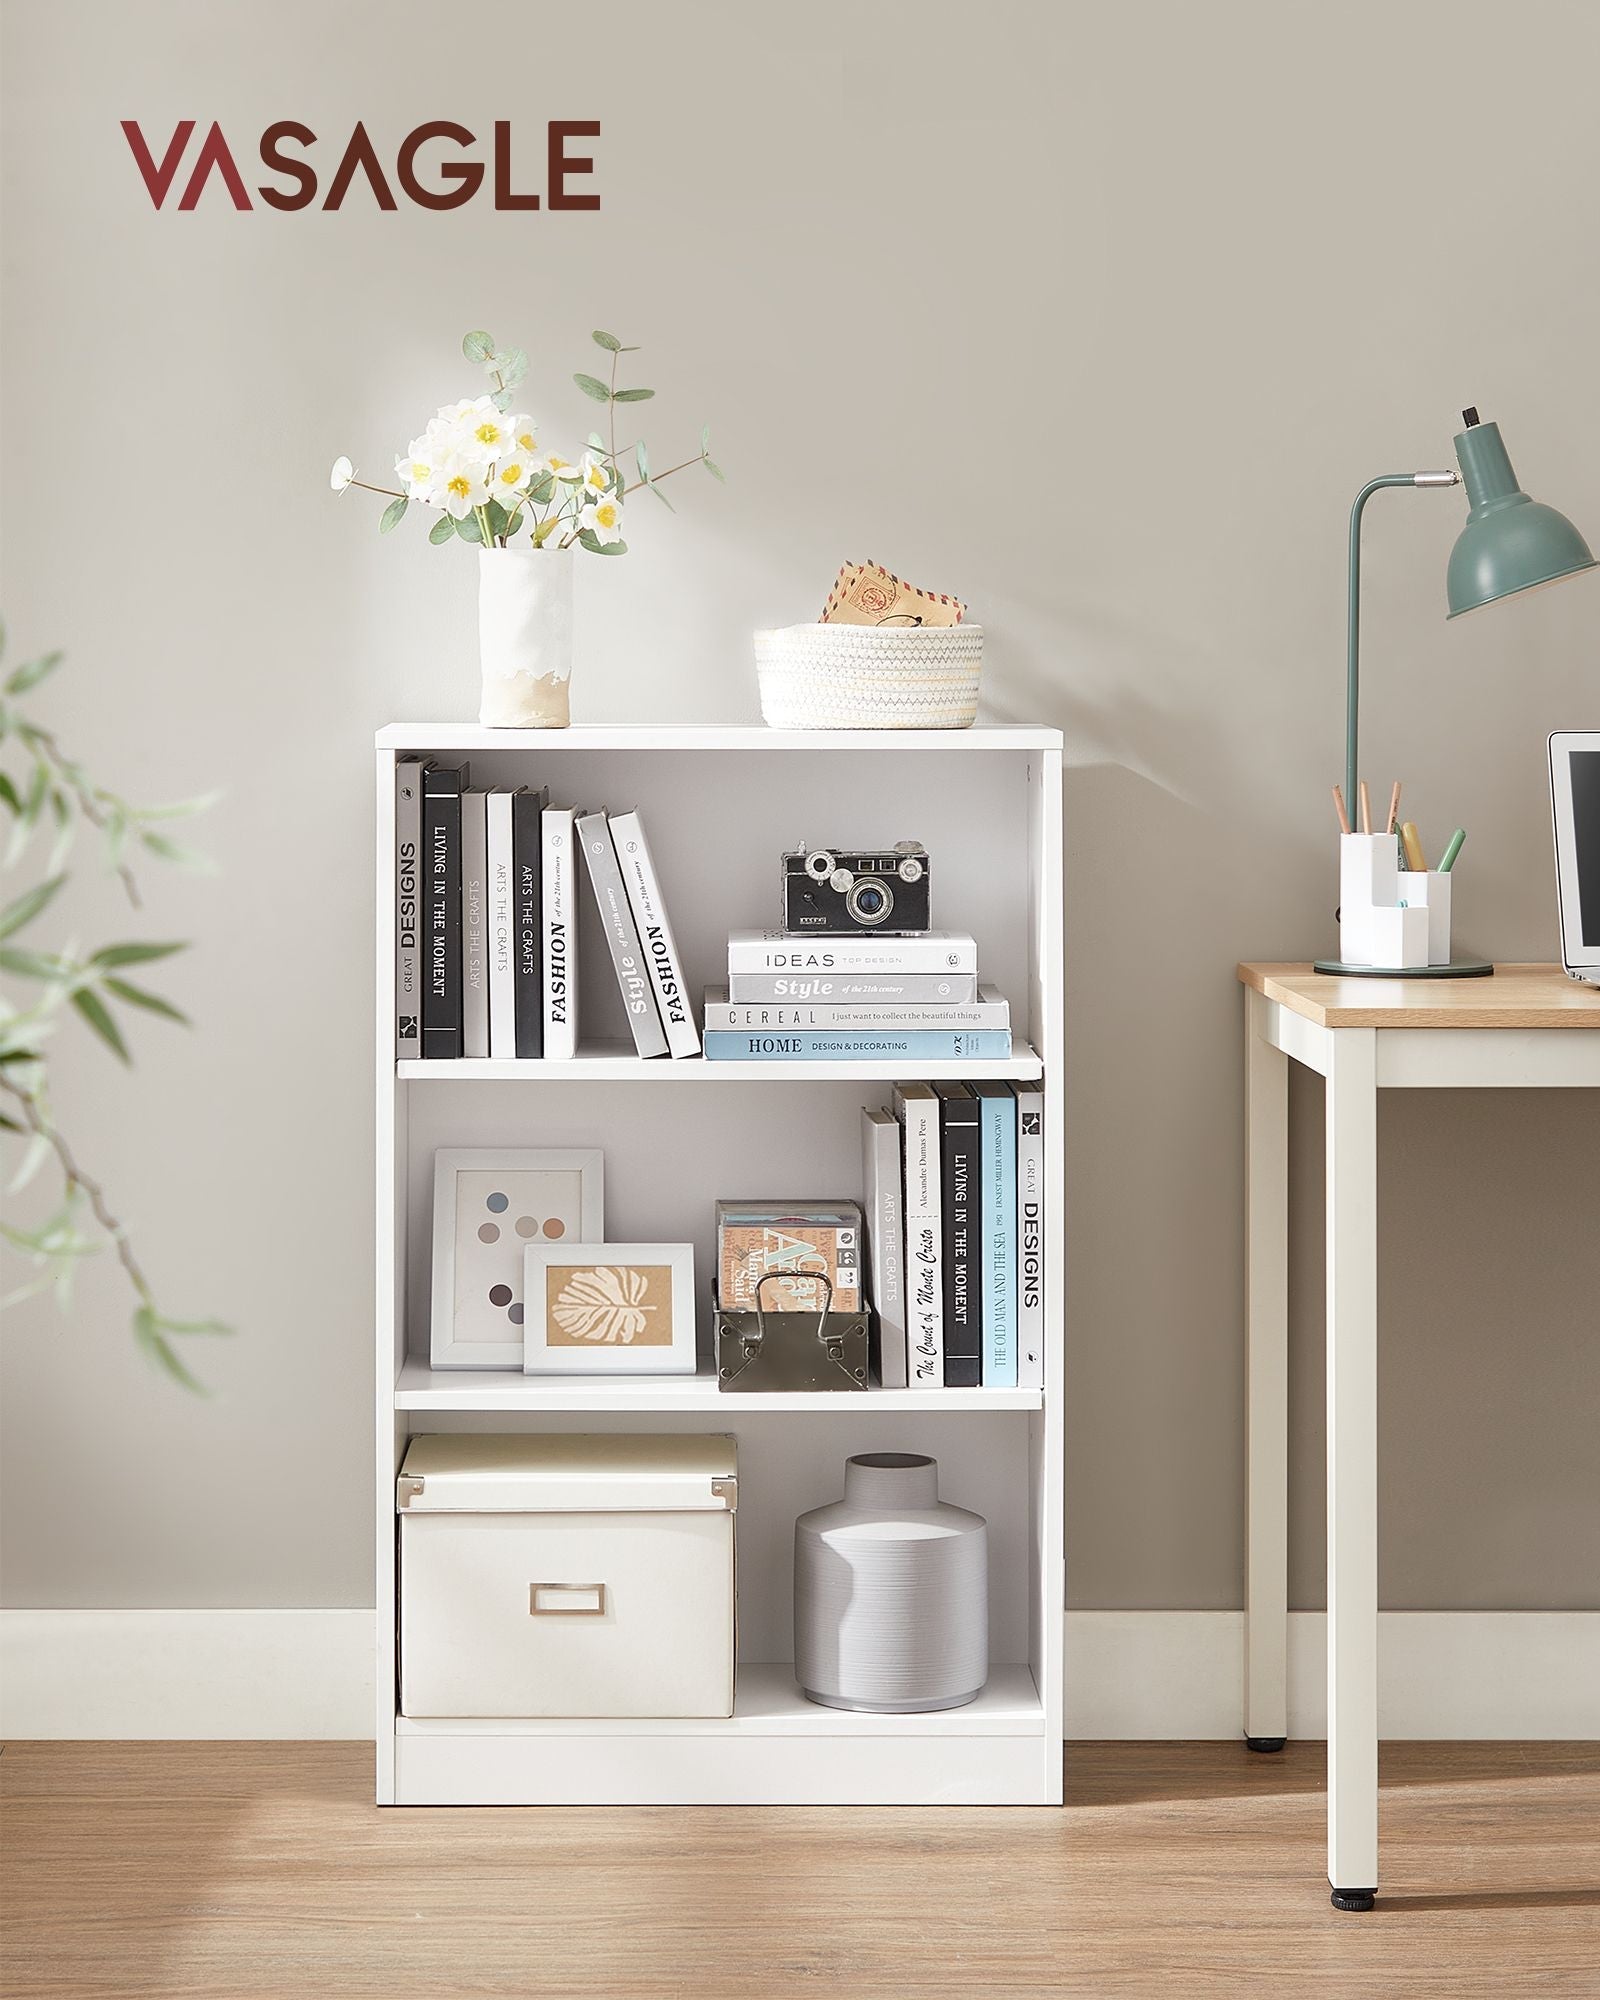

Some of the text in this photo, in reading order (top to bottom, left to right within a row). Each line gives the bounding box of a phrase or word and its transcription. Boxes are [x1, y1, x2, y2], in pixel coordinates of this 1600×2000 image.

[400, 842, 415, 992] GREAT DESIGNS
[433, 826, 448, 996] LIVING IN THE MOMENT
[470, 880, 480, 989] ARTS THE CRAFTS
[496, 864, 508, 972] ARTS THE CRAFTS
[522, 866, 533, 974] ARTS THE CRAFTS
[555, 908, 562, 917] of
[551, 922, 566, 1024] FASHION
[622, 956, 647, 1014] Style
[646, 926, 686, 1024] FASHION
[766, 954, 834, 966] IDEAS
[774, 979, 832, 998] Style
[842, 984, 850, 993] of
[878, 986, 904, 994] century
[729, 1010, 816, 1024] CEREAL
[836, 1013, 851, 1021] just
[922, 1011, 956, 1019] beautiful
[957, 1012, 981, 1021] things
[749, 1039, 802, 1052] HOME
[853, 1042, 907, 1050] DECORATING
[919, 1118, 927, 1208] Alexandre Dumas Pere
[884, 1193, 897, 1301] ARTS THE CRAFTS
[955, 1154, 968, 1324] LIVING IN THE MOMENT
[994, 1232, 1005, 1249] SEA
[994, 1251, 1005, 1270] THE
[1025, 1158, 1038, 1308] GREAT DESIGNS
[735, 1270, 752, 1302] Said
[916, 1229, 939, 1379] The Count of Monte Cristo
[994, 1273, 1006, 1295] AND
[994, 1299, 1006, 1321] MAN
[994, 1324, 1006, 1346] OLD
[994, 1348, 1006, 1368] THE
